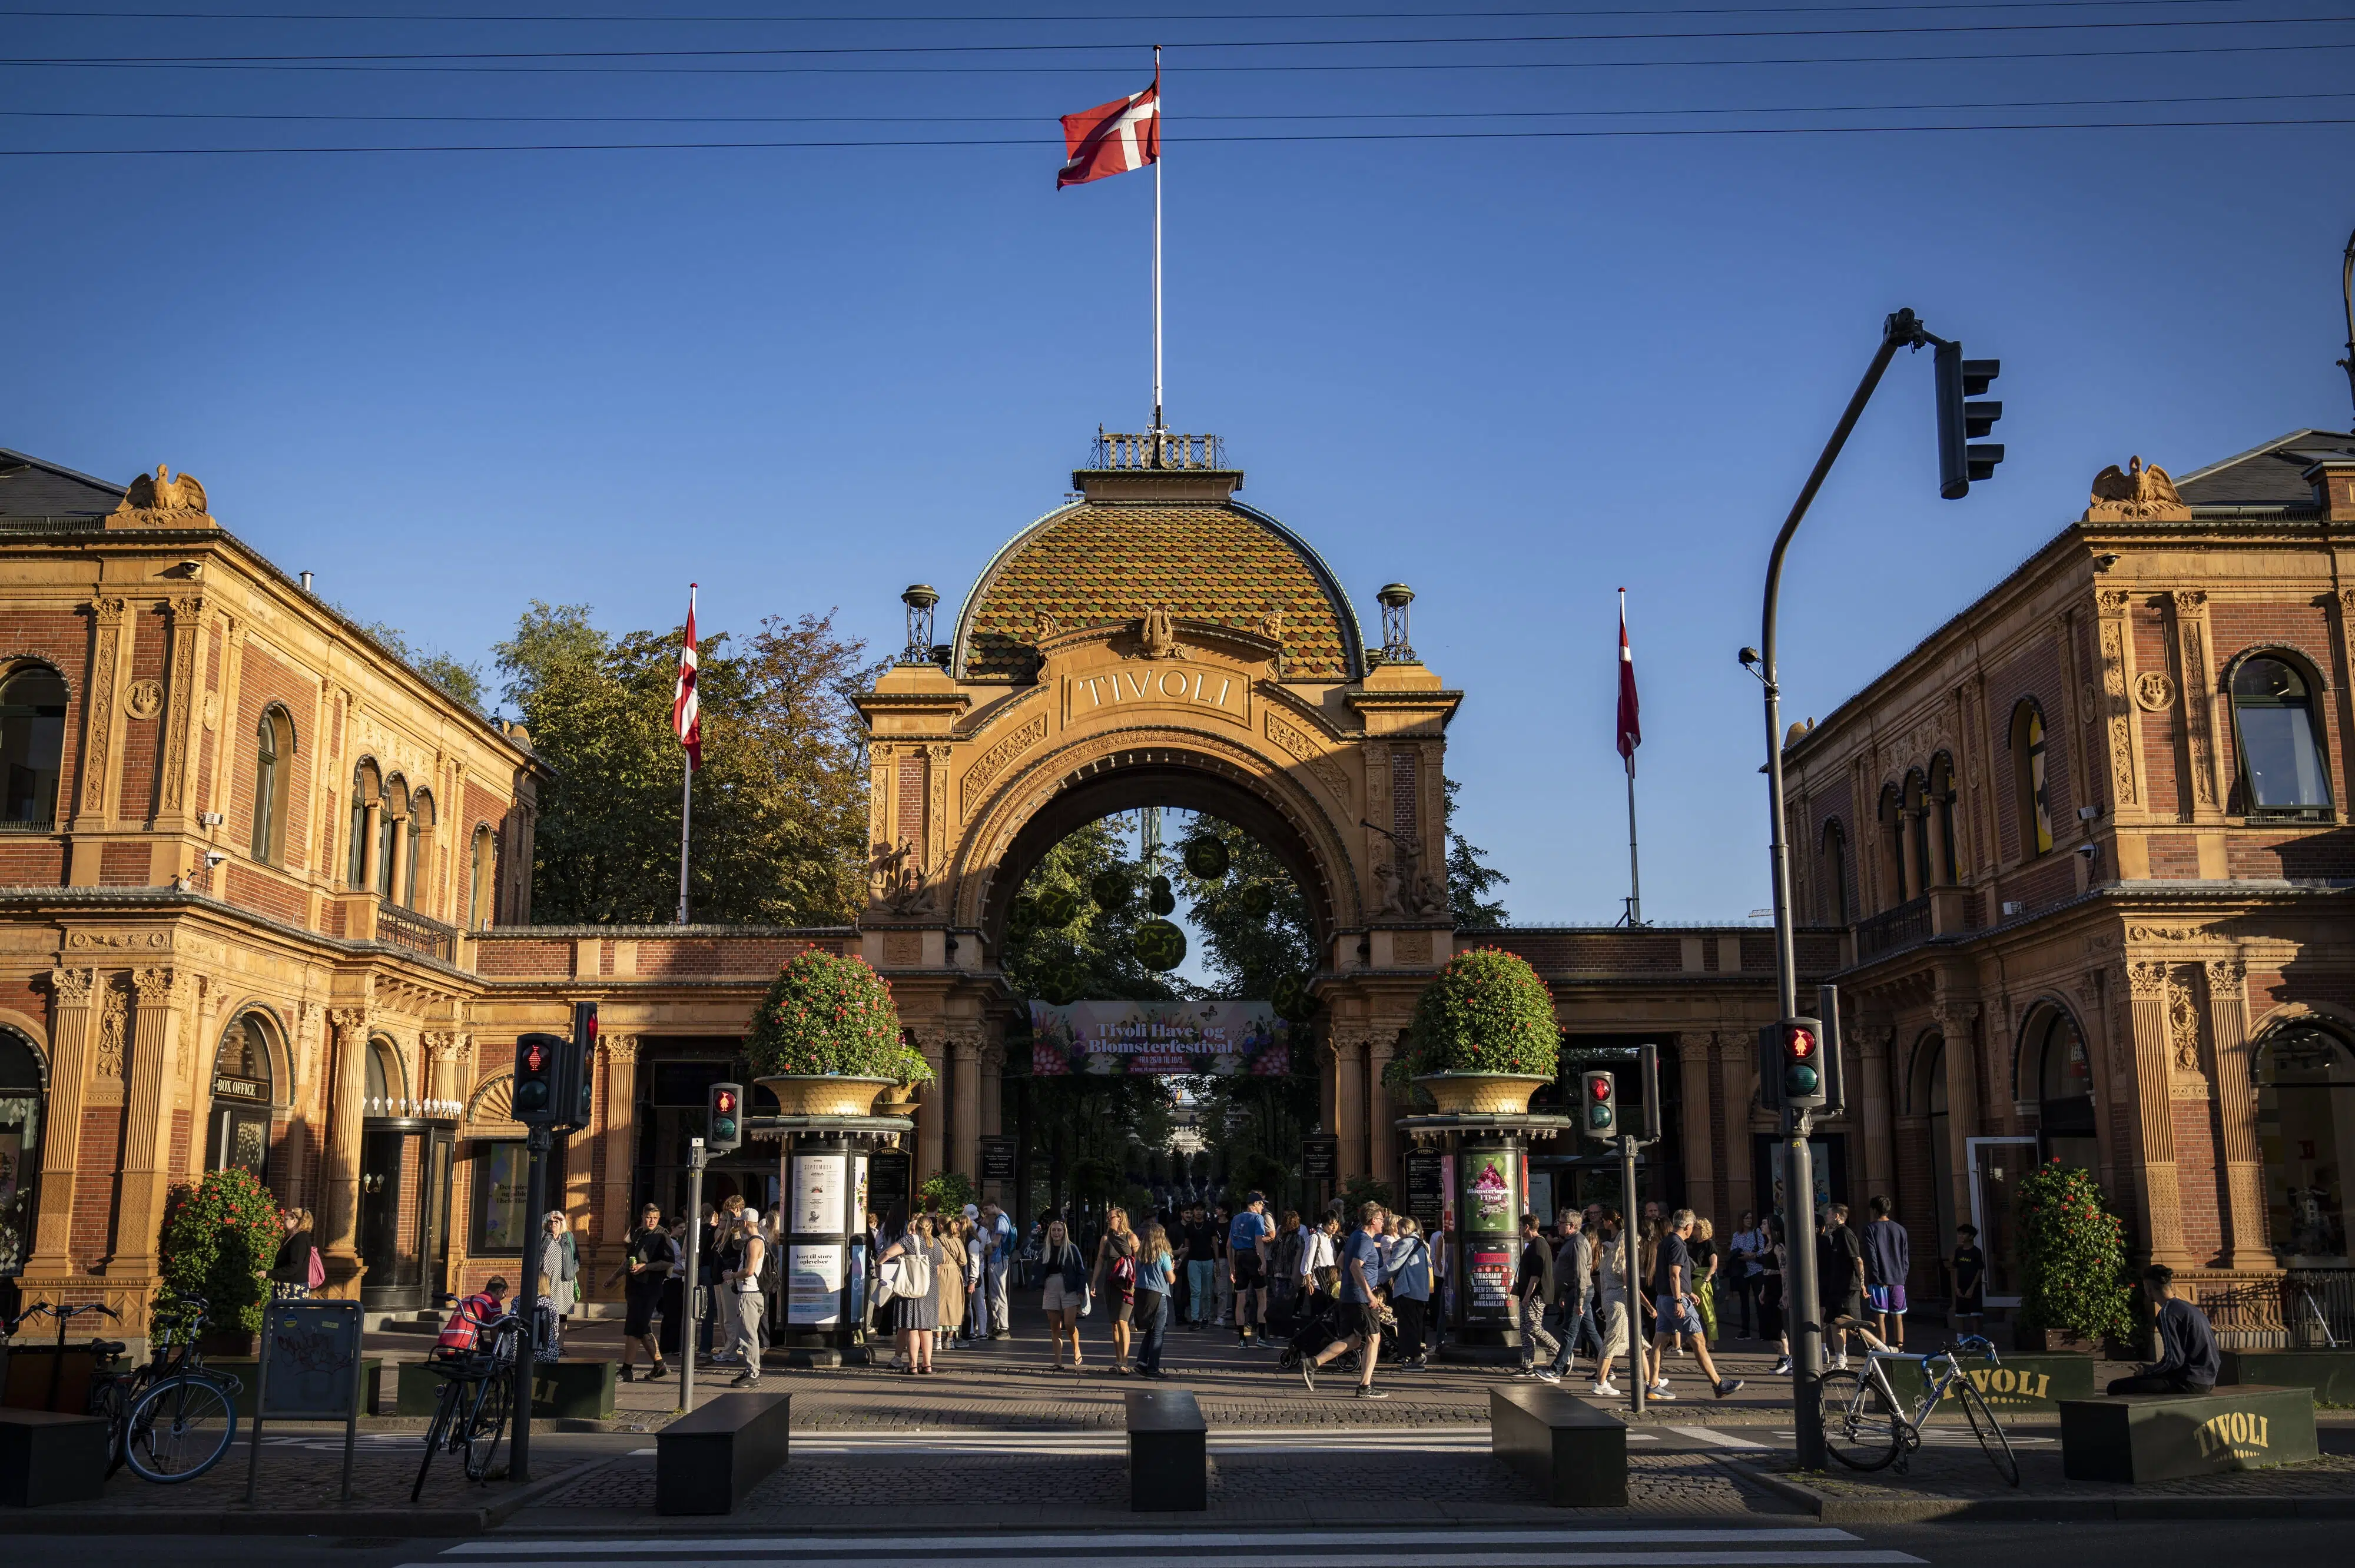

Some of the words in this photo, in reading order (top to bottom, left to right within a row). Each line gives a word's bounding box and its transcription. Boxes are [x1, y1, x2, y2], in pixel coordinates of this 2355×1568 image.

[1079, 669, 1231, 707] TIVOLI
[1096, 1023, 1147, 1038] Tivoli
[1151, 1024, 1199, 1038] Have-
[1203, 1026, 1226, 1041] og
[1088, 1039, 1233, 1054] Blomsterfestival
[217, 1079, 231, 1092] BOX
[233, 1081, 256, 1096] OFFICE
[2193, 1412, 2268, 1458] TIVOLI
